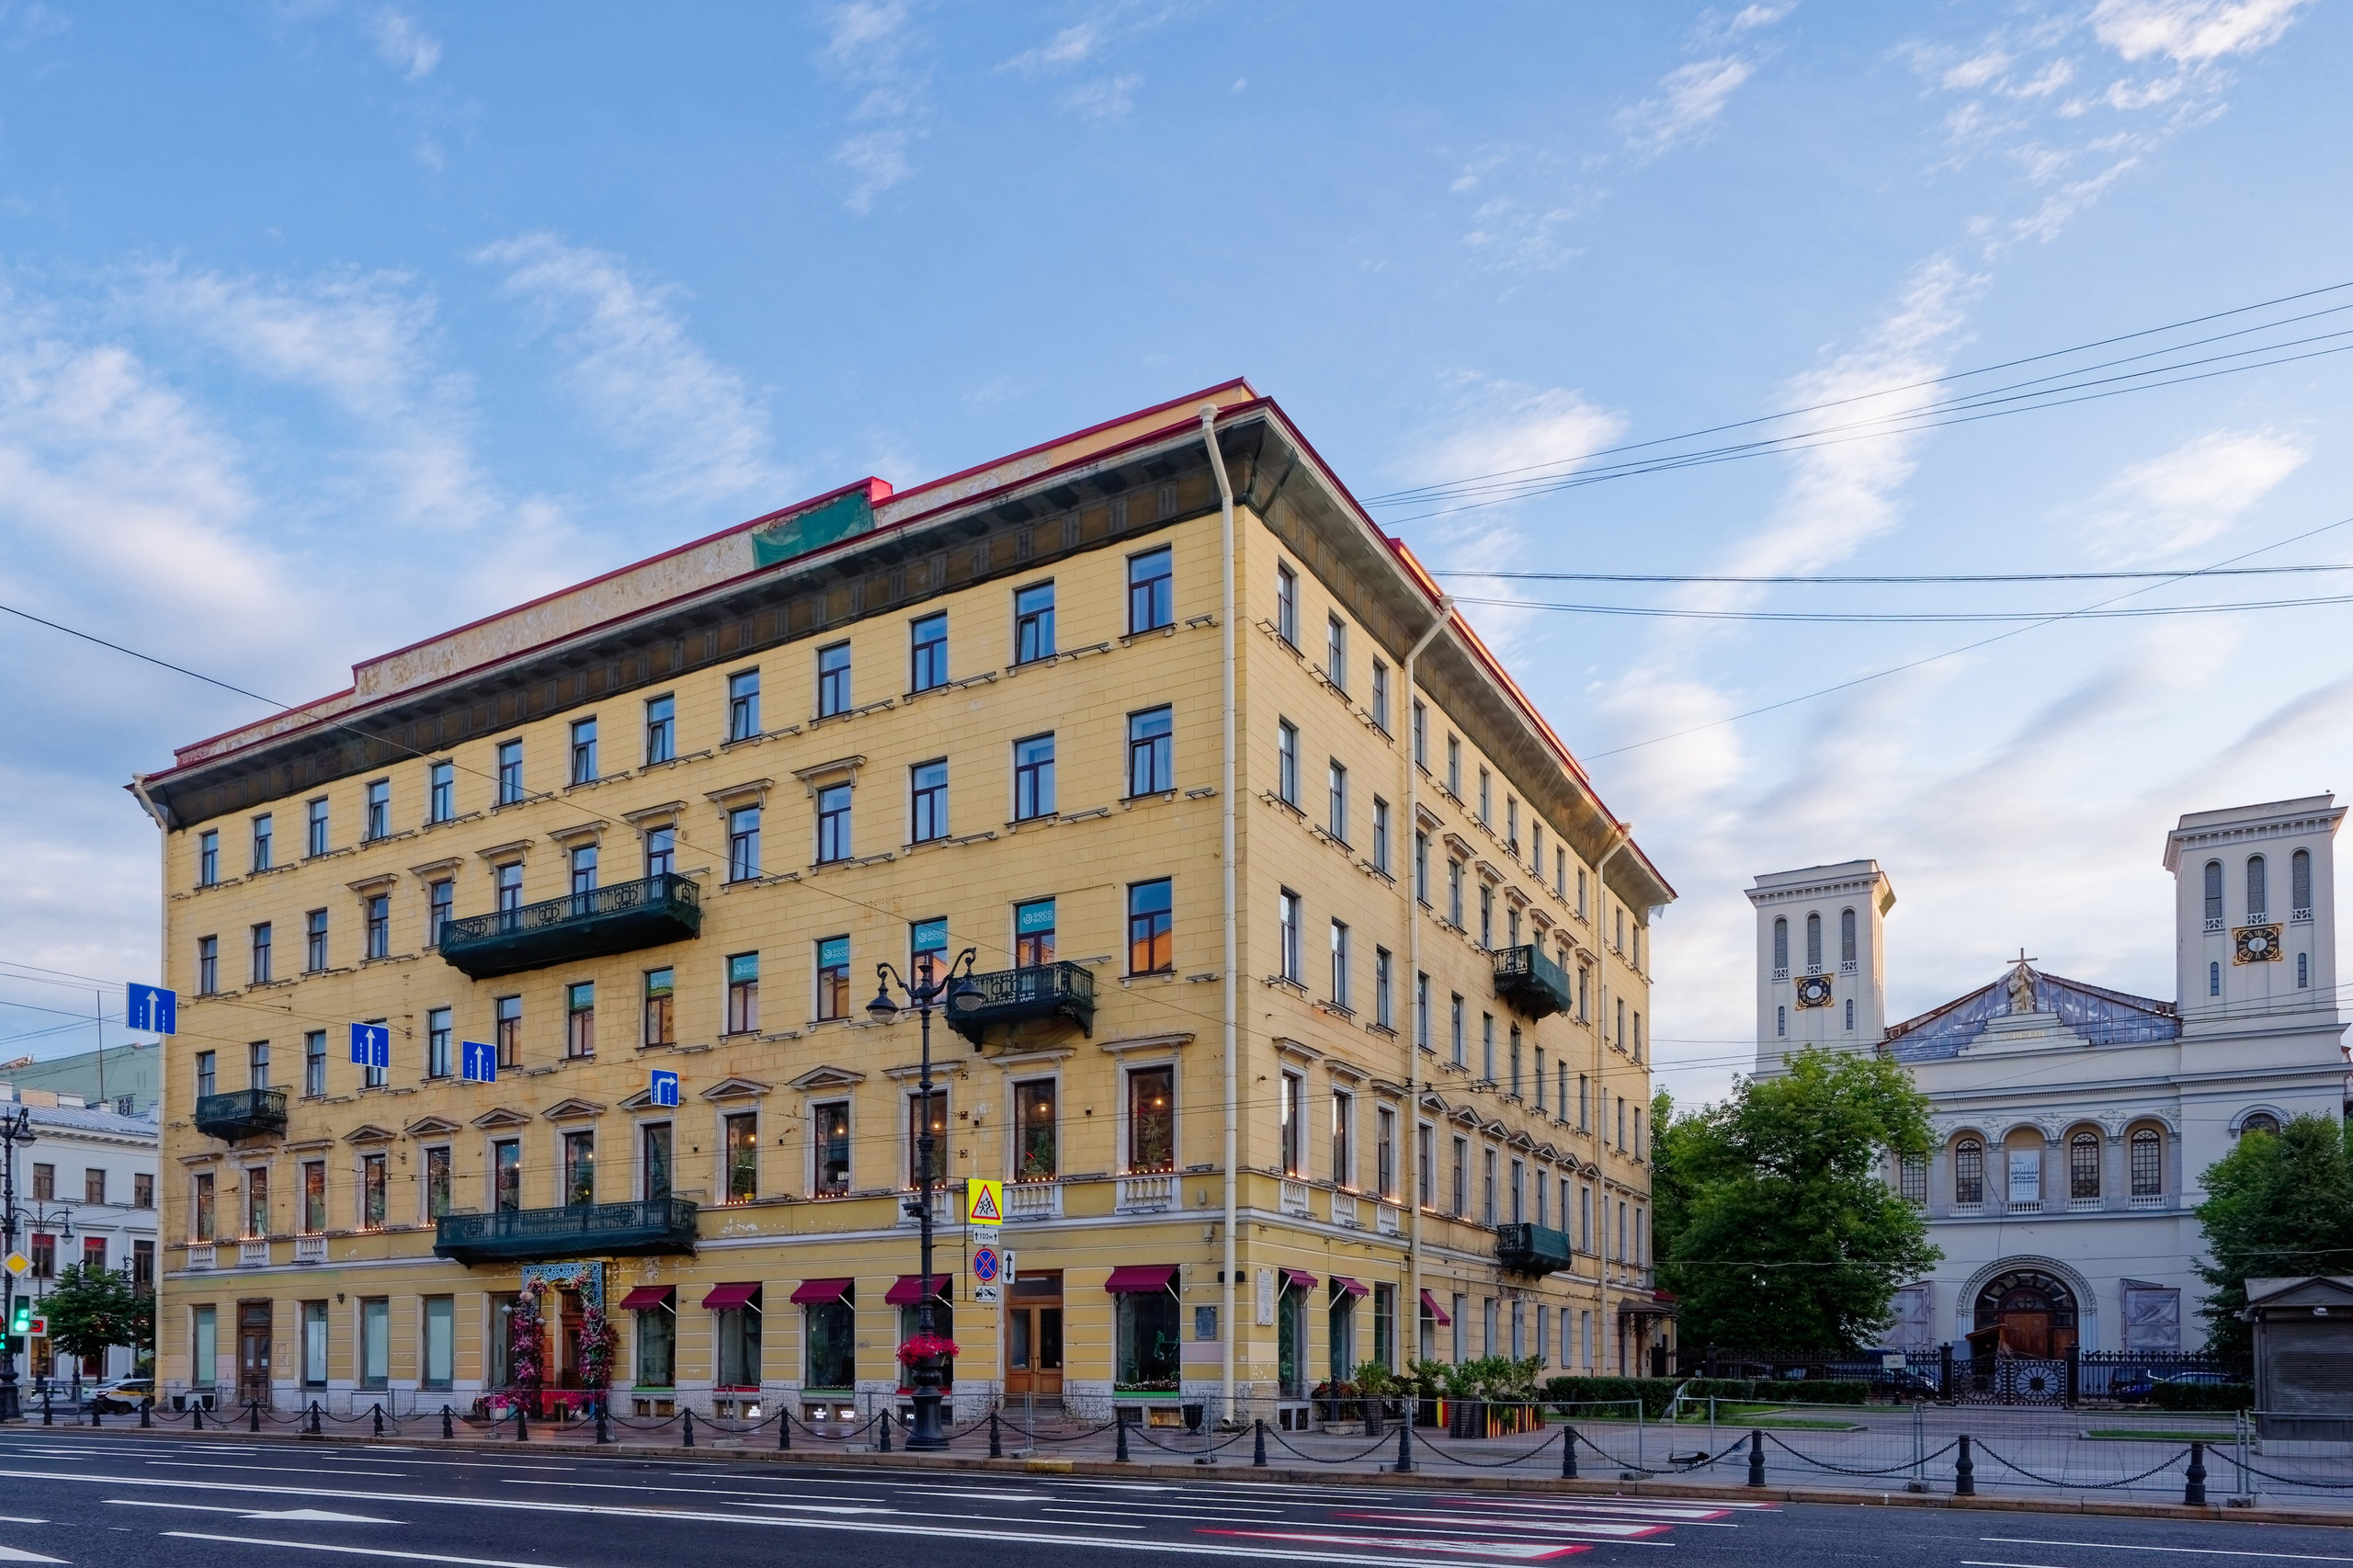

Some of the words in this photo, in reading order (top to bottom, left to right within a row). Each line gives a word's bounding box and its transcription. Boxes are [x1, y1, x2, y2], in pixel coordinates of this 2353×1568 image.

[1033, 915, 1052, 924] WOOD
[926, 928, 946, 937] GOOD
[926, 934, 946, 942] WOOD
[832, 946, 849, 954] GOOD
